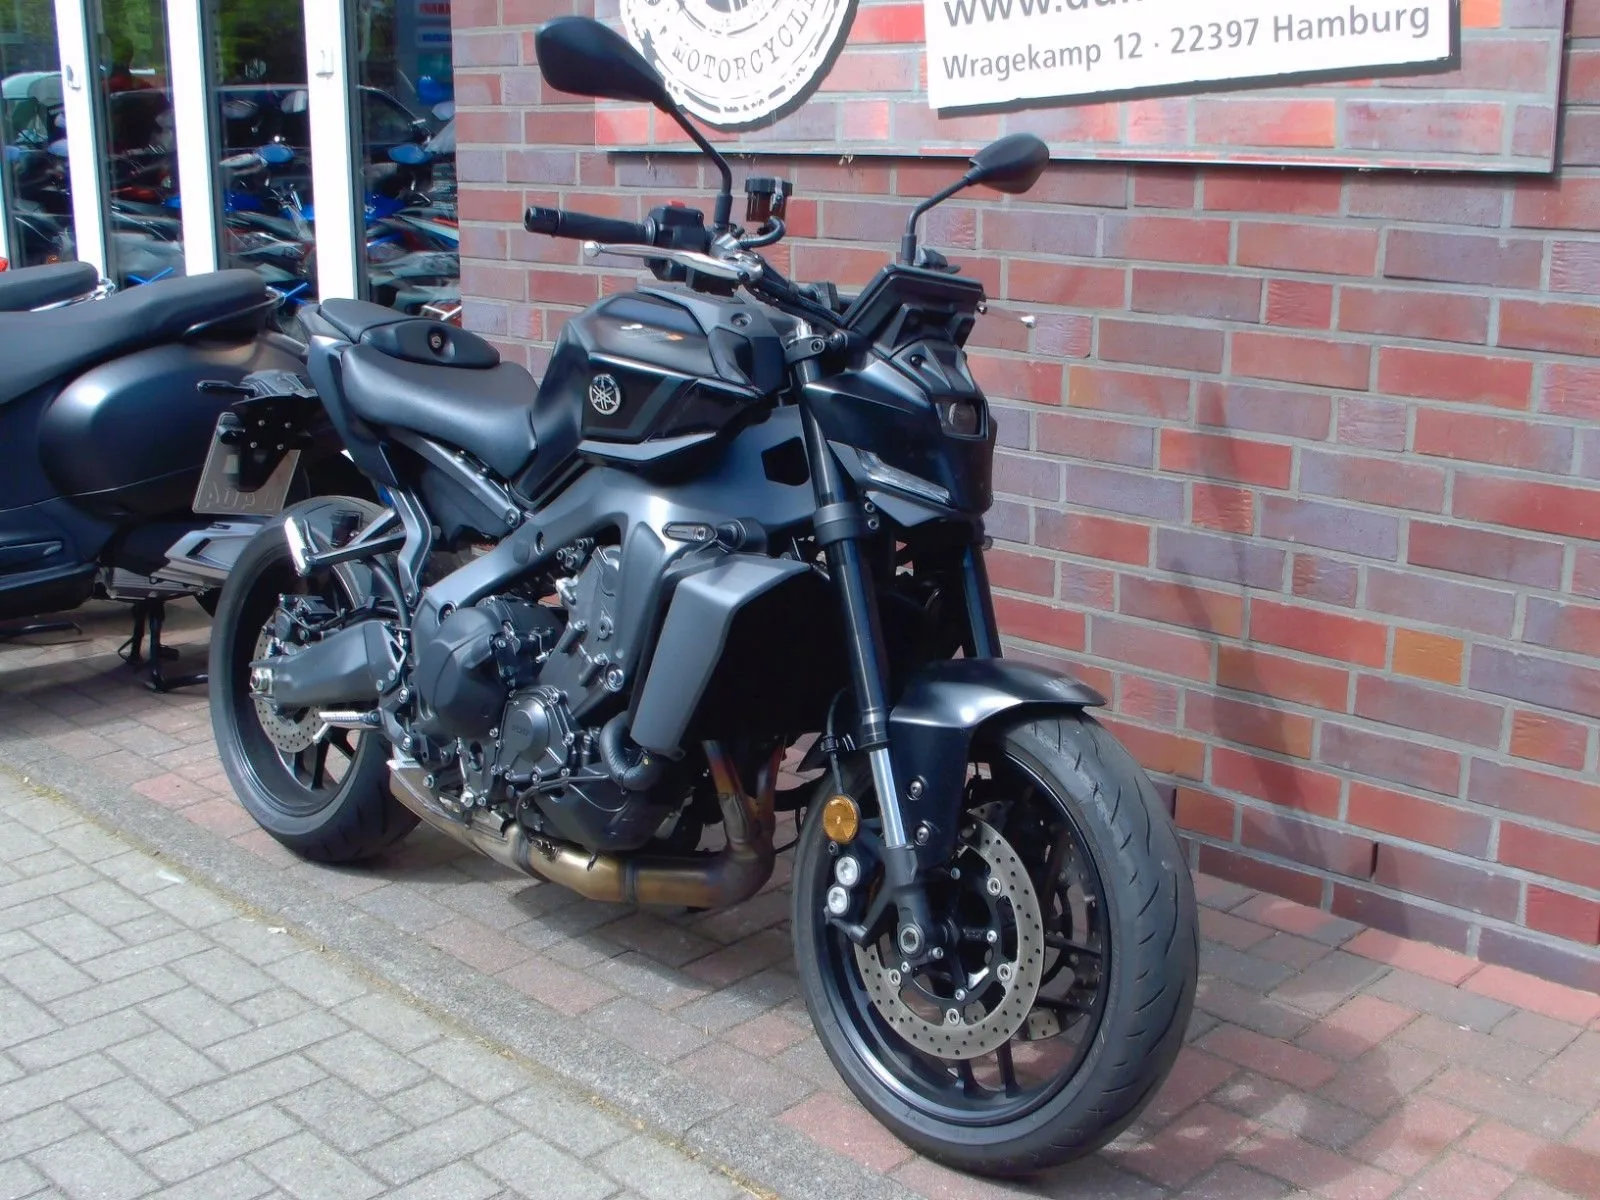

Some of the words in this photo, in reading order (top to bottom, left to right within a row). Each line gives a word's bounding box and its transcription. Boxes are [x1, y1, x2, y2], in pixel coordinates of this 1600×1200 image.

[942, 43, 1102, 81] Wragekamp
[1113, 32, 1143, 60] 12
[1170, 18, 1259, 54] 22397
[1273, 5, 1430, 43] Hamburg
